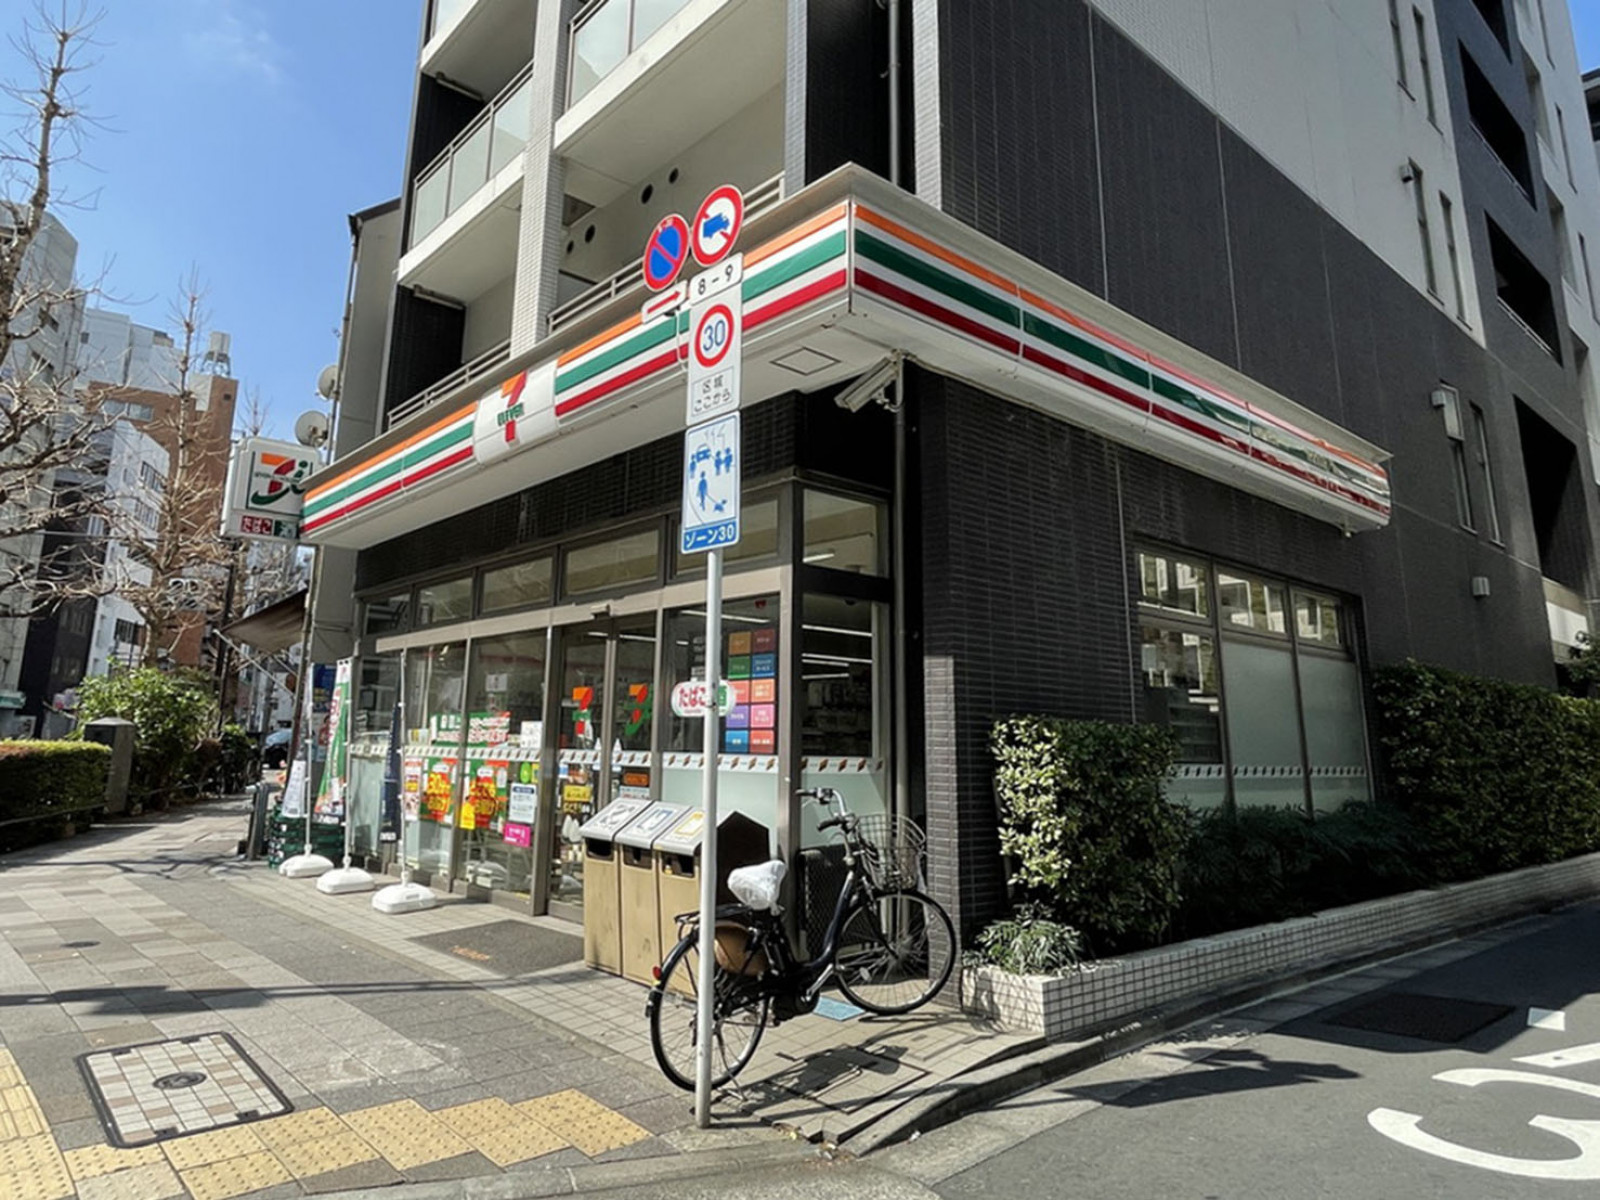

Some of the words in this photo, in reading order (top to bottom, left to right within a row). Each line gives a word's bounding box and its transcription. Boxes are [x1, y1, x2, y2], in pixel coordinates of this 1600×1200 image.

[702, 319, 726, 351] 30
[694, 388, 731, 412] ここから
[243, 516, 272, 535] たばこ
